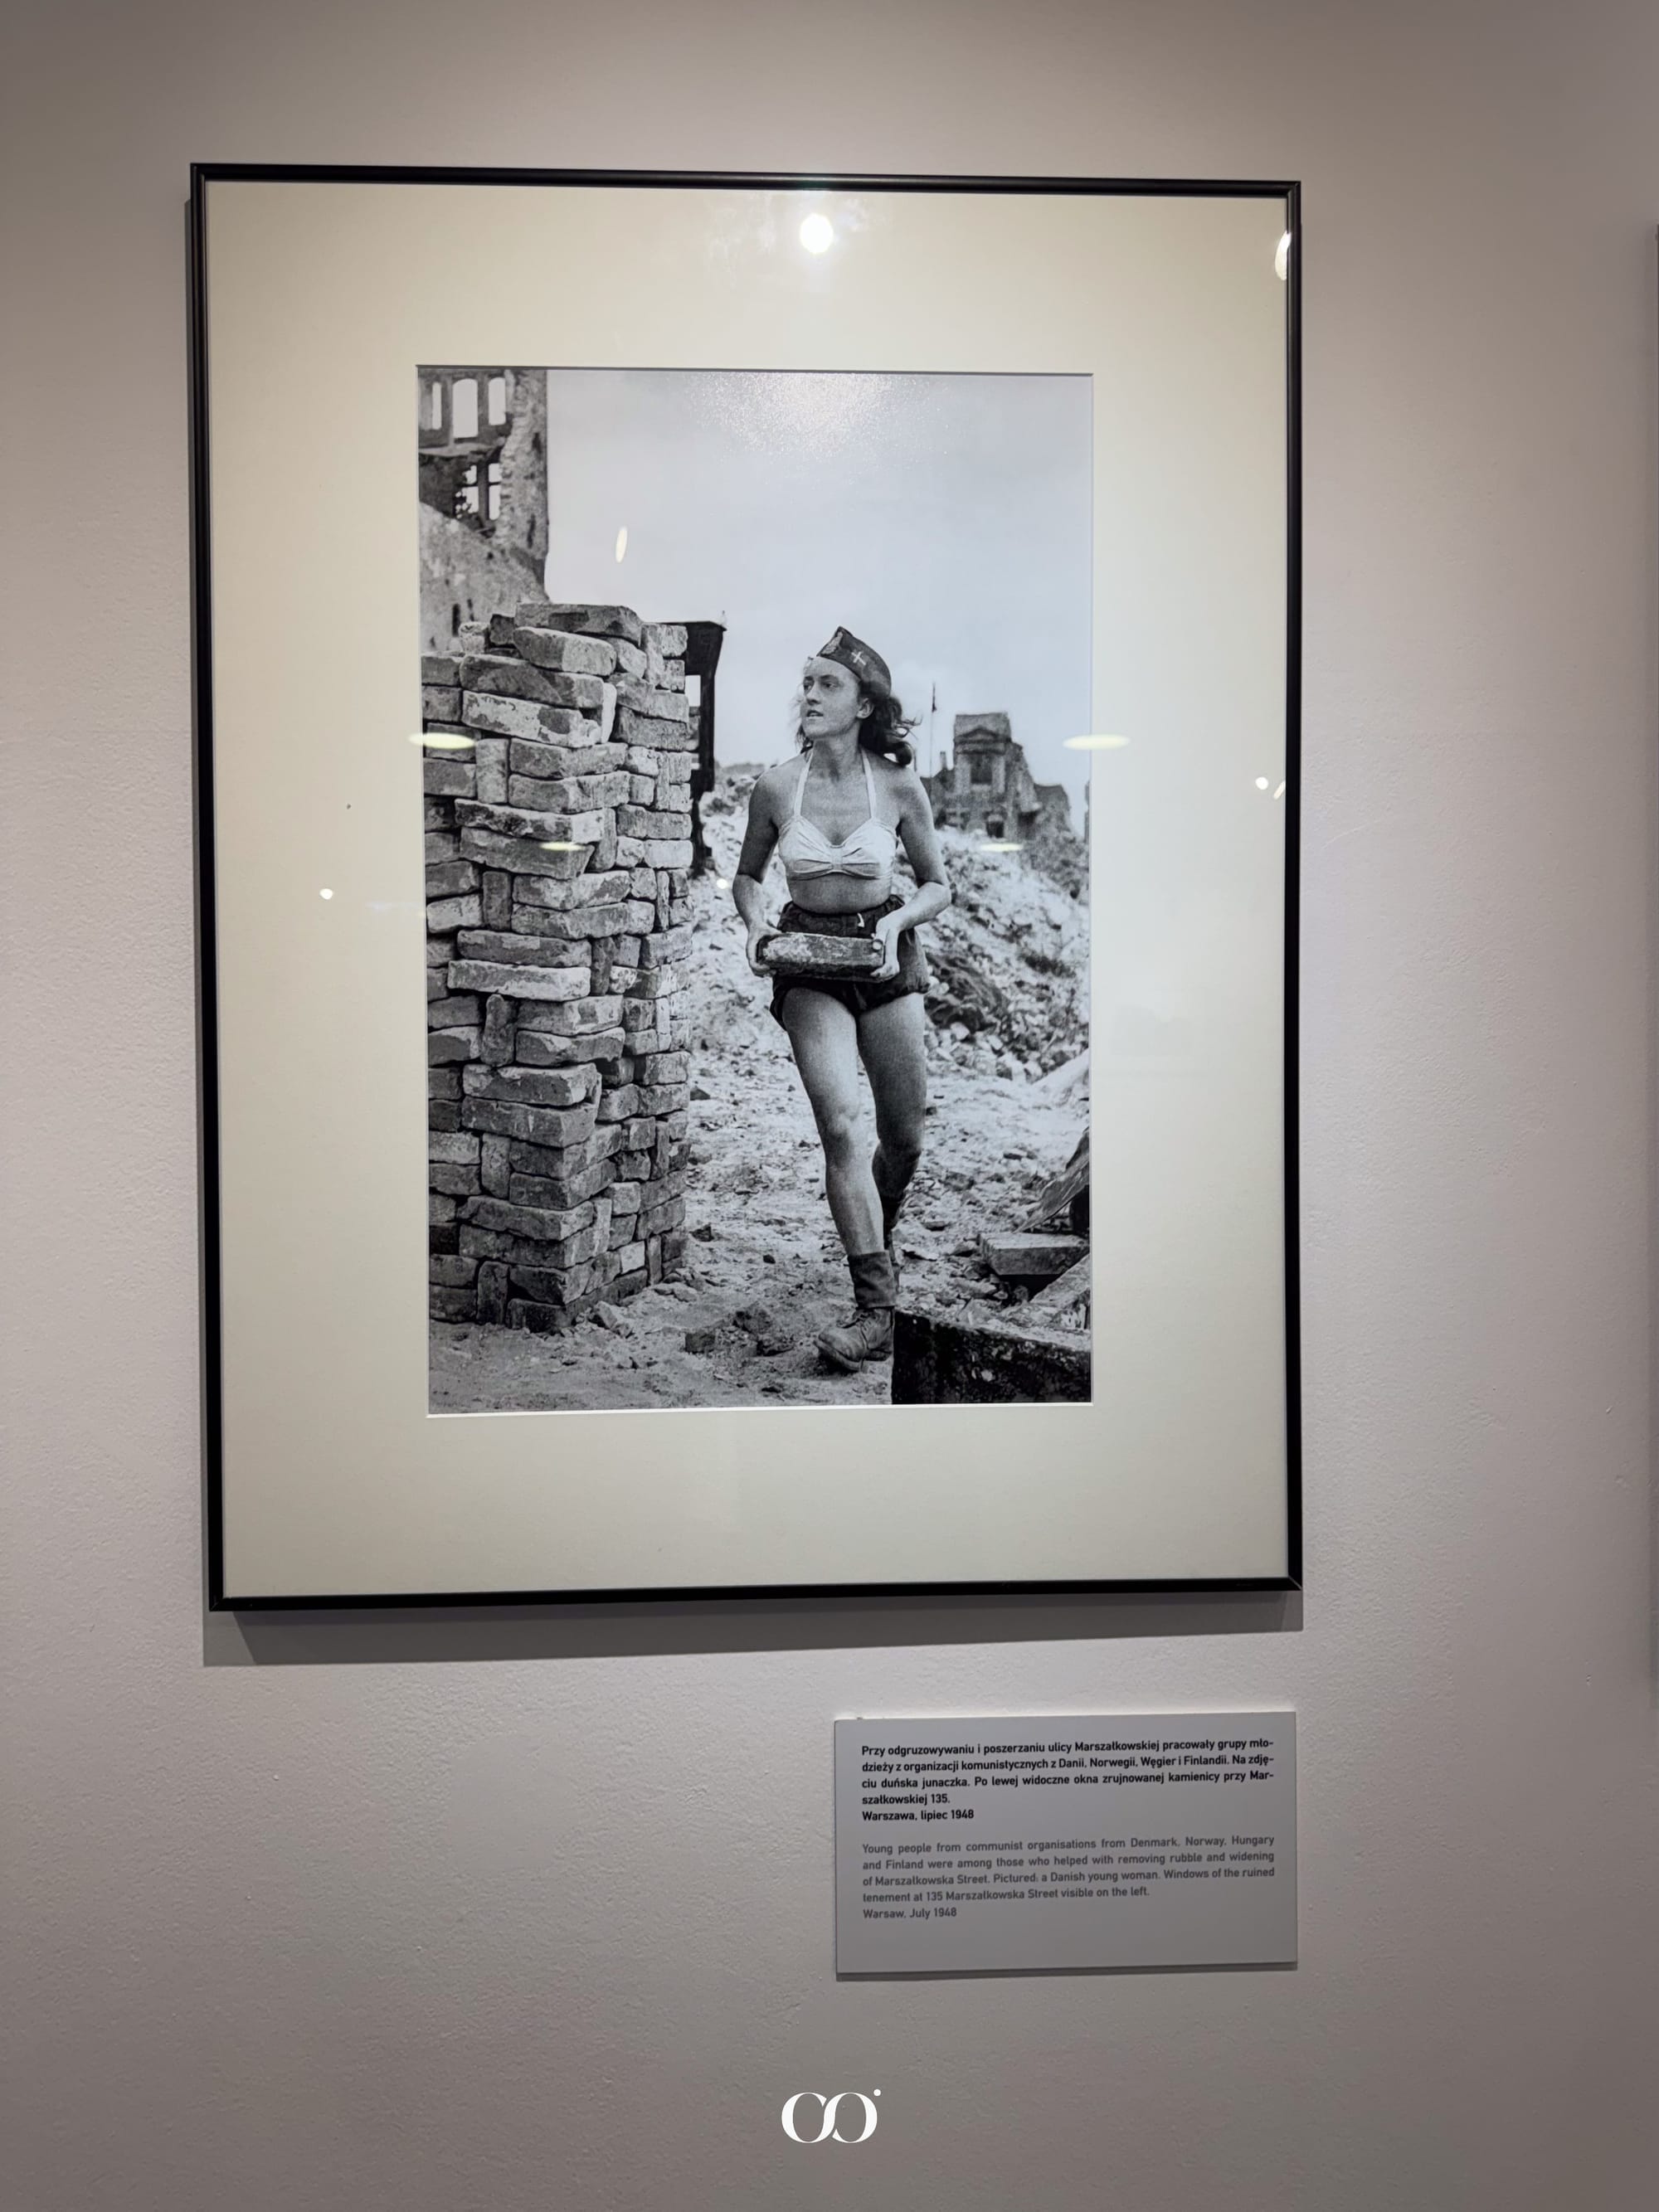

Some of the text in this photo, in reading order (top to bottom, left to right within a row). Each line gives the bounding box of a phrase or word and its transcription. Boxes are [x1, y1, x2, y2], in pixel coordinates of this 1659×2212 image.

[861, 1738, 1274, 1758] Przy odgruzowywaniu i poszerzaniu ulicy Marszałkowskiej pracowały grupy mło-
[862, 1761, 894, 1775] dzieży
[895, 1763, 902, 1772] z
[903, 1760, 959, 1774] organizacji
[961, 1757, 1048, 1772] komunistycznych
[1050, 1760, 1057, 1769] z
[1140, 1756, 1177, 1769] Węgier
[1178, 1755, 1181, 1766] i
[1184, 1754, 1230, 1766] Finlandii.
[1232, 1754, 1247, 1765] Na
[1248, 1753, 1274, 1767] zdję-
[861, 1769, 1274, 1791] ciu duńska junaczka. Po lewej widoczne okna zrujnowanej kamienicy przy Mar-
[862, 1792, 951, 1806] szałkowskiej 135.
[921, 1809, 948, 1823] lipiec
[951, 1808, 975, 1820] 1948
[862, 1843, 893, 1856] Young
[898, 1842, 932, 1856] people
[937, 1842, 961, 1853] from
[966, 1840, 1024, 1852] communist
[1027, 1838, 1097, 1853] organisations
[1101, 1838, 1126, 1849] from
[1231, 1835, 1275, 1848] Hungary
[863, 1850, 1274, 1870] and Finland were among those who helped with removing rubble and widening
[863, 1875, 873, 1887] of
[956, 1874, 990, 1884] Street.
[1041, 1874, 1048, 1883] a
[1050, 1871, 1086, 1883] Danish
[1087, 1872, 1118, 1884] young
[1121, 1871, 1160, 1880] woman.
[1163, 1868, 1209, 1879] Windows
[1211, 1867, 1222, 1879] of
[1224, 1867, 1240, 1878] the
[1242, 1866, 1275, 1878] ruined
[863, 1892, 911, 1903] tenement
[913, 1892, 923, 1902] at
[926, 1890, 943, 1902] 135
[1028, 1888, 1058, 1899] Street
[1060, 1887, 1094, 1898] visible
[1096, 1889, 1109, 1898] on
[1112, 1886, 1128, 1897] the
[1131, 1885, 1150, 1897] left.
[909, 1908, 931, 1921] July
[933, 1907, 957, 1918] 1948
